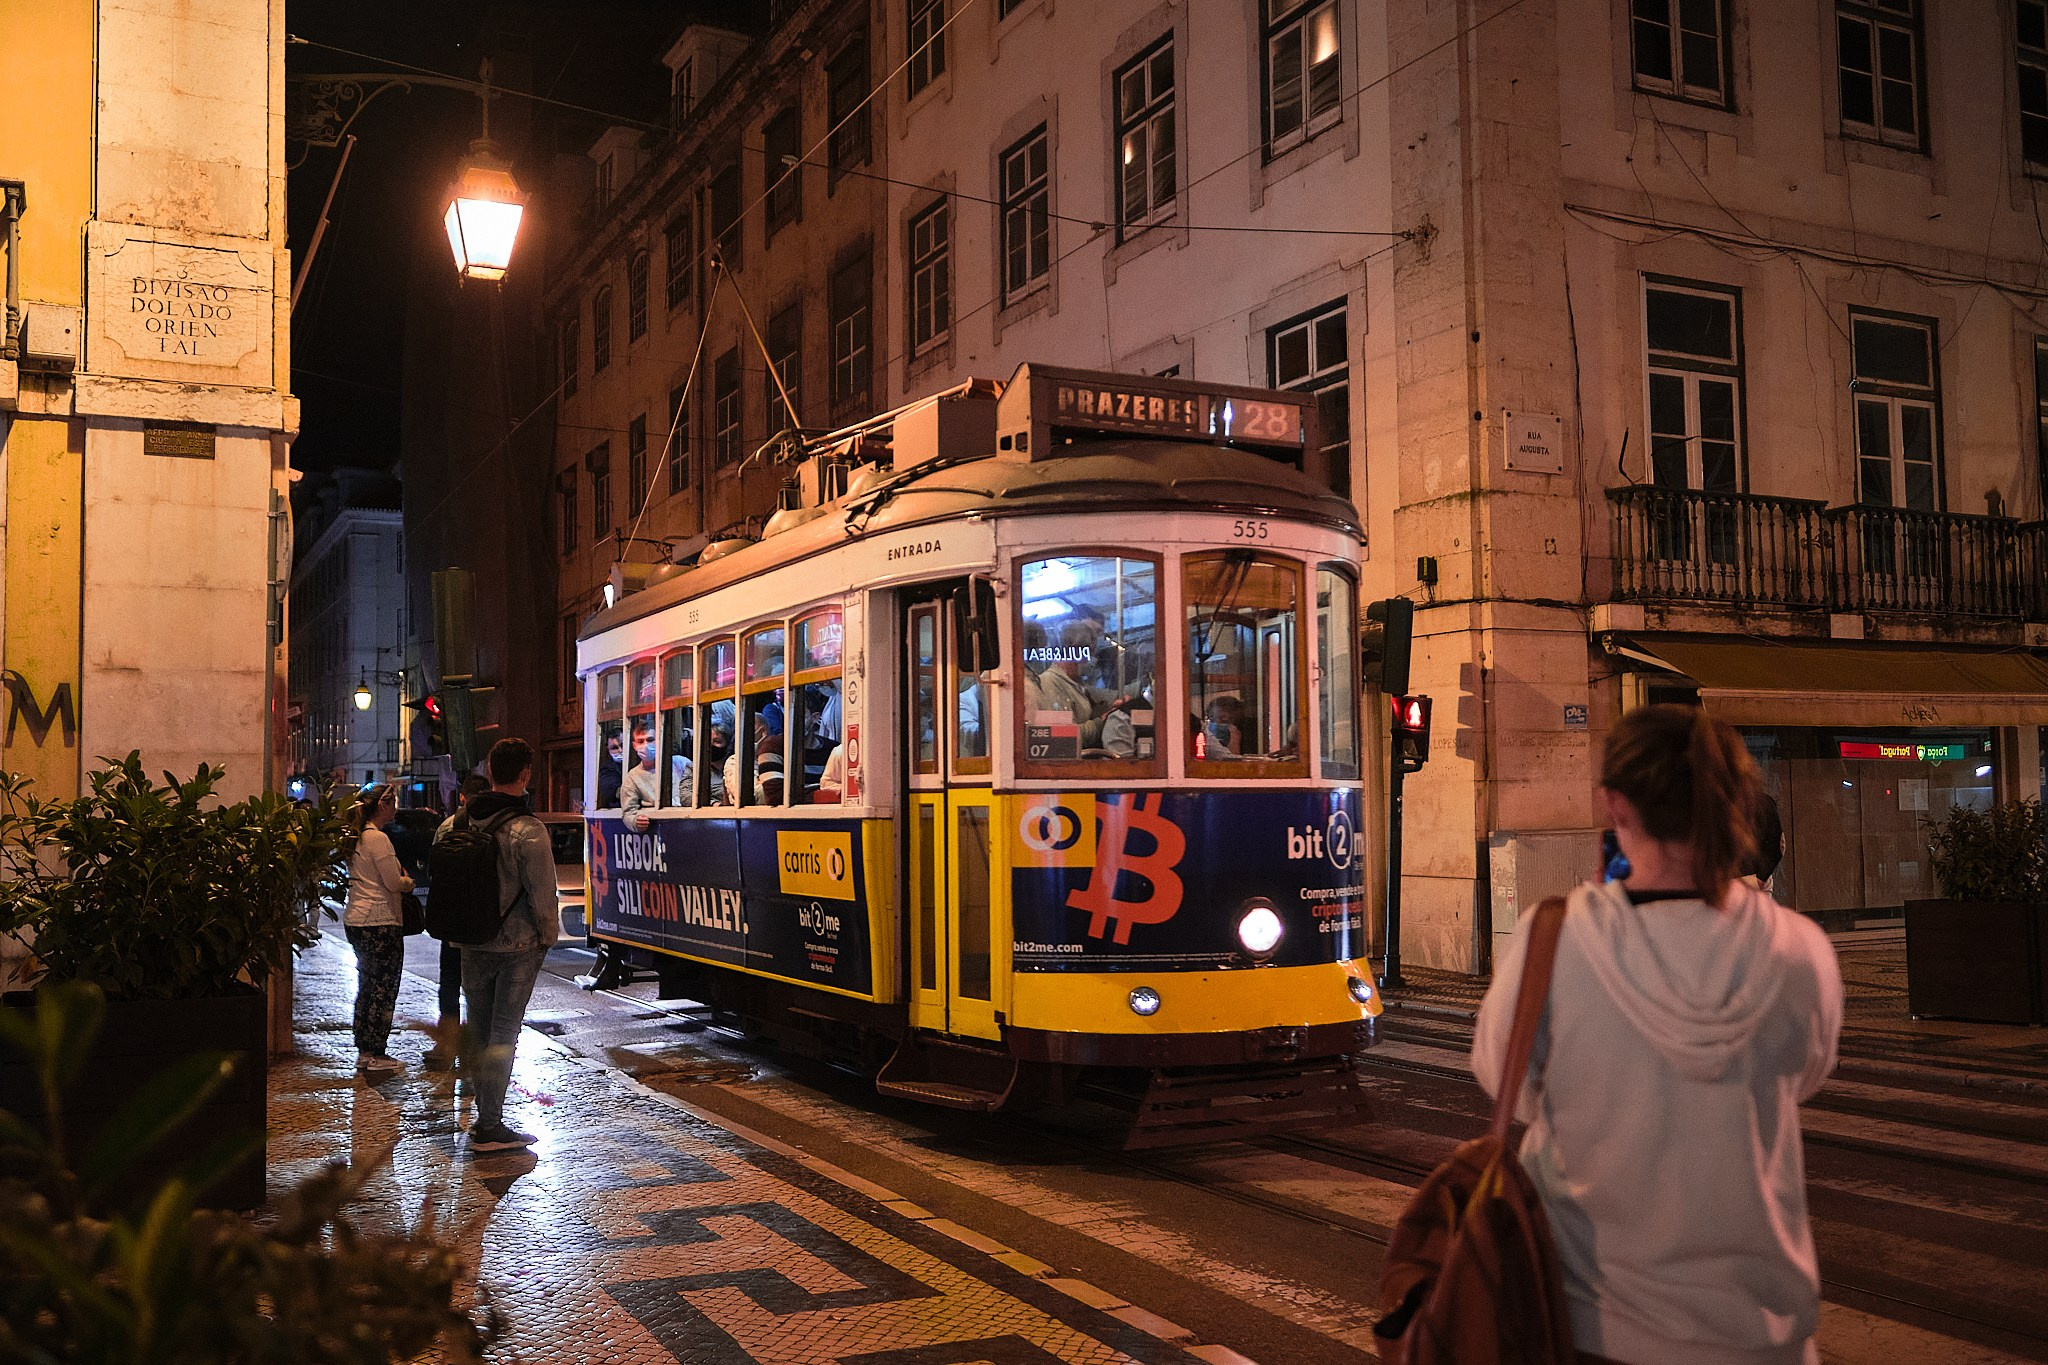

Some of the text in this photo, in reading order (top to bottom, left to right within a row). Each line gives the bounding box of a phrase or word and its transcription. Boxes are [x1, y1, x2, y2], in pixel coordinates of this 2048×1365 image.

[145, 317, 218, 338] ORIEN
[155, 337, 206, 356] TAL
[1058, 386, 1288, 436] PRAZERES 28
[1527, 431, 1542, 440] RUA
[1519, 444, 1550, 455] AUGUSTA
[1233, 520, 1268, 539] 555
[888, 539, 942, 561] ENTRADA
[689, 609, 699, 624] 555
[1031, 728, 1050, 738] 28E
[1030, 744, 1049, 757] 07
[614, 833, 667, 873] LISBOA:
[784, 843, 821, 875] carris
[678, 884, 749, 935] VALLEY.
[1319, 920, 1330, 933] de
[1013, 941, 1084, 953] bit2me.com
